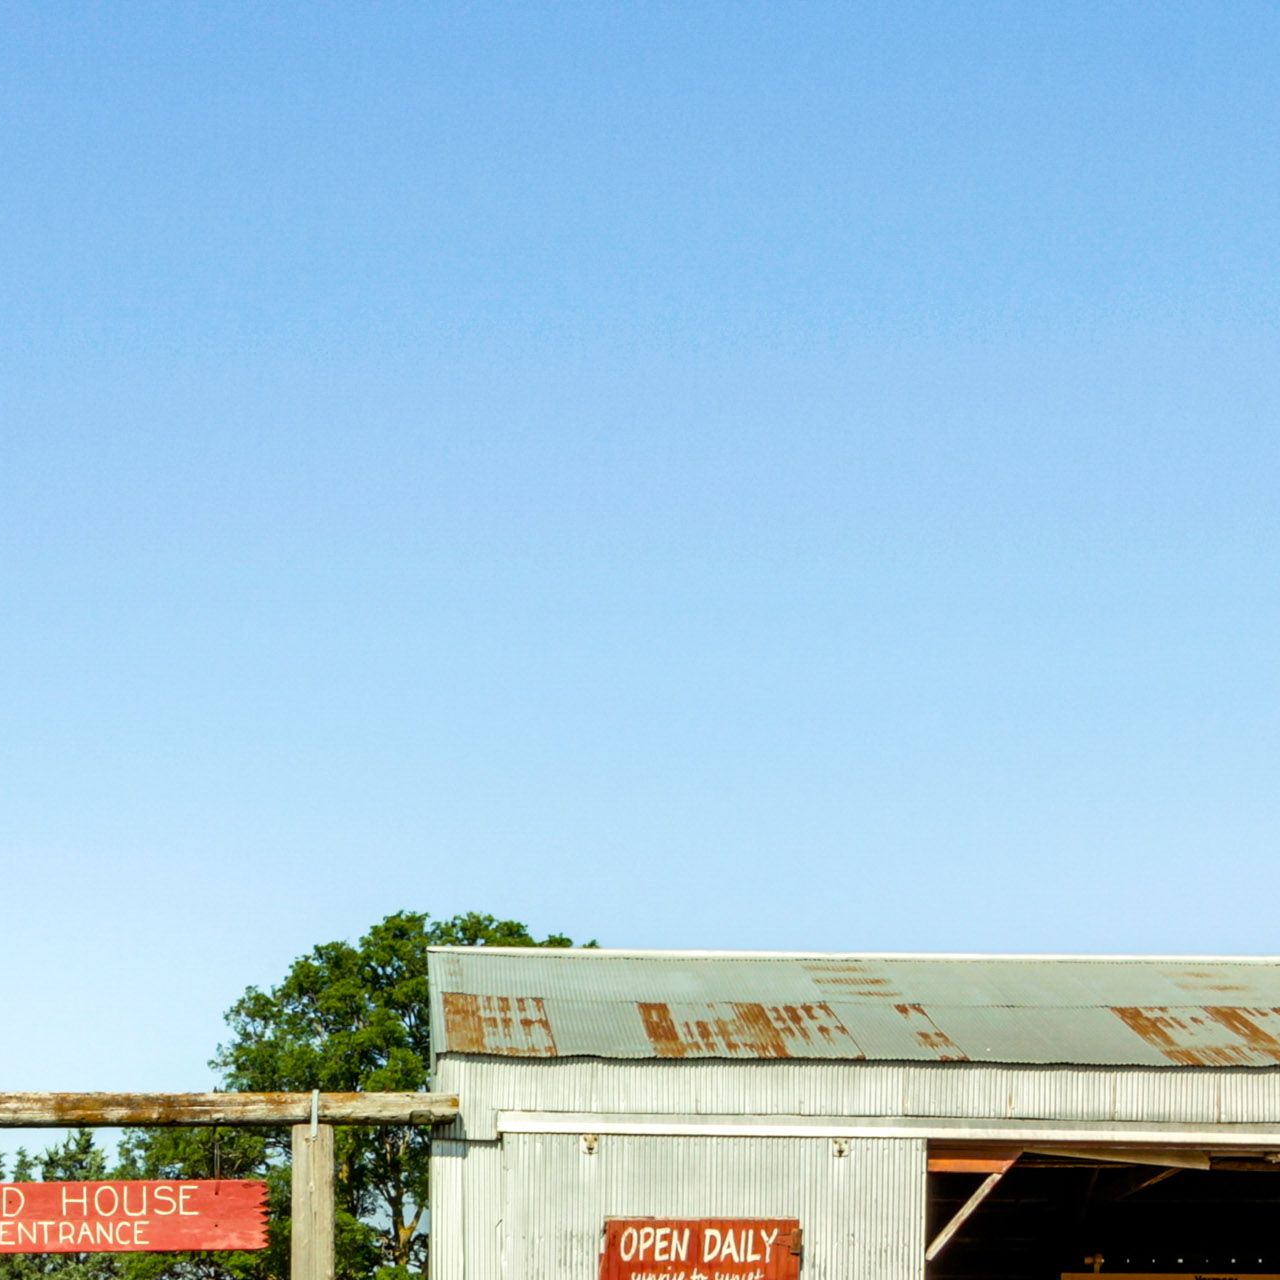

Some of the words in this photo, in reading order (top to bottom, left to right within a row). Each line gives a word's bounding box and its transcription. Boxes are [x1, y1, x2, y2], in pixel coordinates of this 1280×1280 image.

[61, 1185, 200, 1217] HOUSE
[620, 1226, 690, 1262] OPEN
[703, 1227, 779, 1263] DAILY
